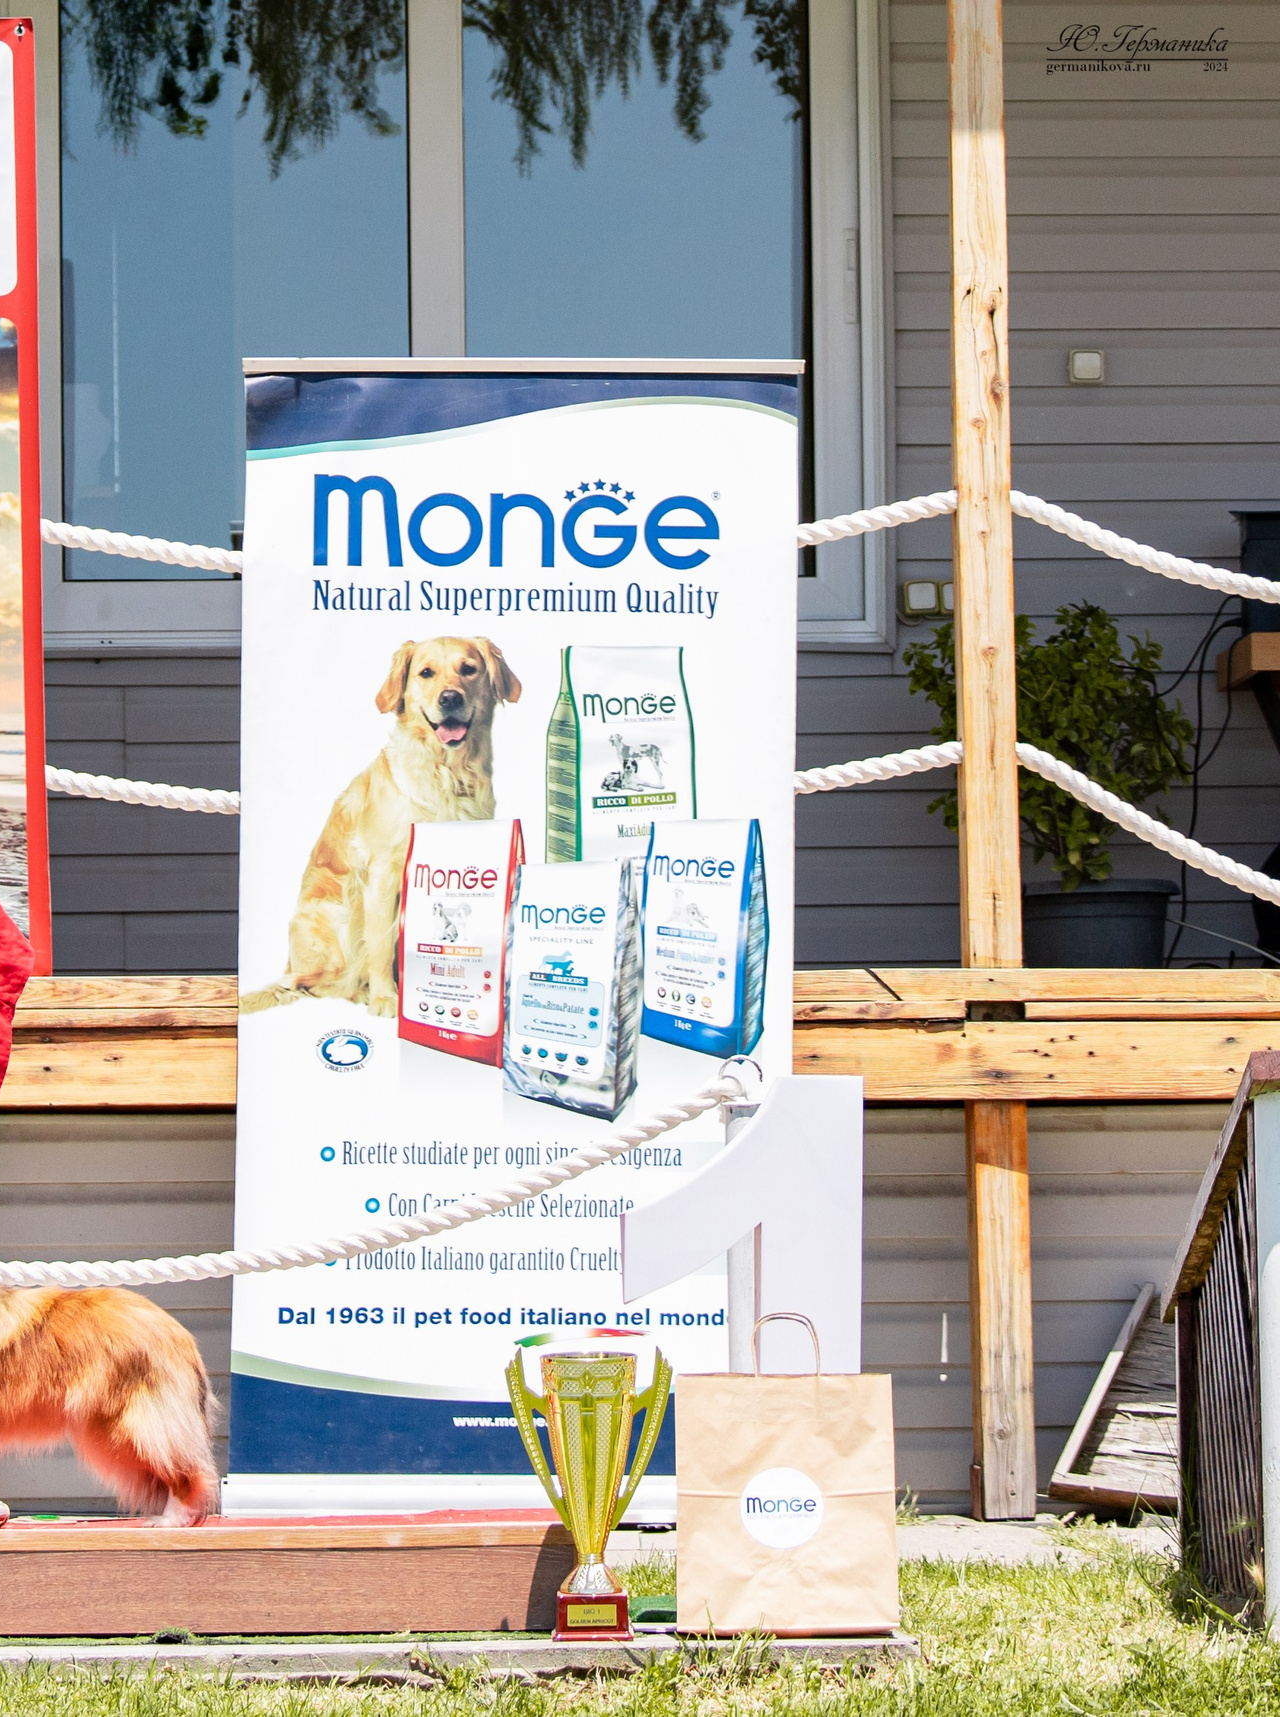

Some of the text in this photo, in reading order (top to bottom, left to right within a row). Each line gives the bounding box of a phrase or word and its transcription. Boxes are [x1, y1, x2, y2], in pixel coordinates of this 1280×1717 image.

[312, 579, 719, 620] Natural Superpremium Quality
[596, 794, 674, 807] RICCO DI POLLO
[529, 936, 573, 944] SPECIALITY
[342, 1140, 398, 1165] Ricette
[403, 1141, 468, 1165] studiate
[473, 1146, 500, 1169] per
[505, 1141, 541, 1169] ogni
[388, 1193, 417, 1217] Con
[540, 1193, 634, 1218] Selezionate
[345, 1248, 415, 1270] rodotto
[421, 1246, 484, 1270] Italiano
[489, 1247, 565, 1274] garantito
[278, 1307, 729, 1328] Dal 1963 il pet food italiano nel mond
